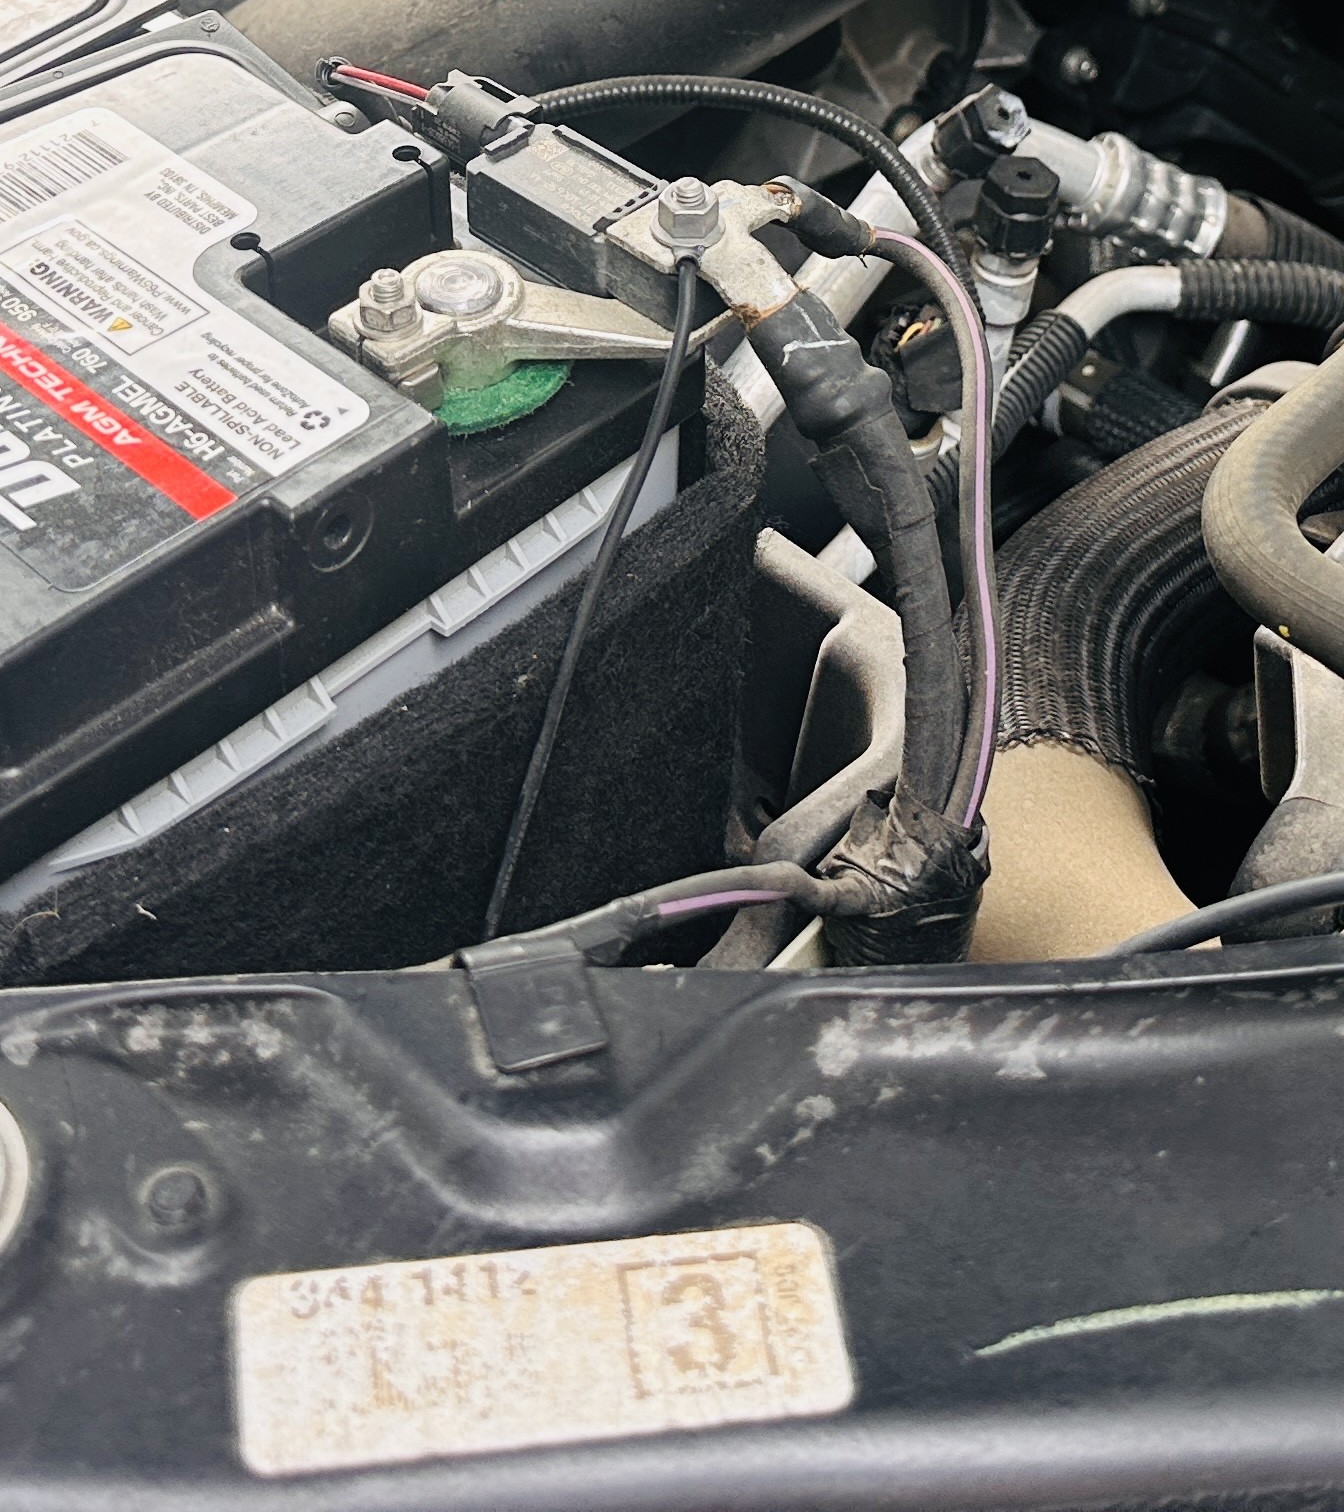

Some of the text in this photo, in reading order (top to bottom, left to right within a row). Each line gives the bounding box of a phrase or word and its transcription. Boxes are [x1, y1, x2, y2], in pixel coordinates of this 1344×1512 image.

[16, 131, 75, 163] 21112
[168, 190, 207, 214] PARTS,
[180, 181, 202, 194] TN
[141, 188, 214, 235] DISTRIBUTED BY
[195, 208, 227, 228] BEST
[50, 256, 118, 302] Reproductive
[58, 224, 197, 317] www.P65Warnings.ca.gov
[87, 266, 117, 285] after
[106, 297, 134, 314] and
[107, 279, 144, 303] hands
[134, 298, 170, 322] Wash
[123, 308, 167, 338] Cancer
[67, 345, 111, 374] 760
[197, 330, 312, 410] AutoZone for proper recycling
[203, 351, 300, 418] Return used batteries to
[68, 398, 145, 445] AGM
[102, 373, 228, 462] H6-AGMEL
[171, 379, 287, 460] NON-SPILLABLE
[182, 365, 303, 450] Lead Acid Battery
[662, 1272, 738, 1374] 3
